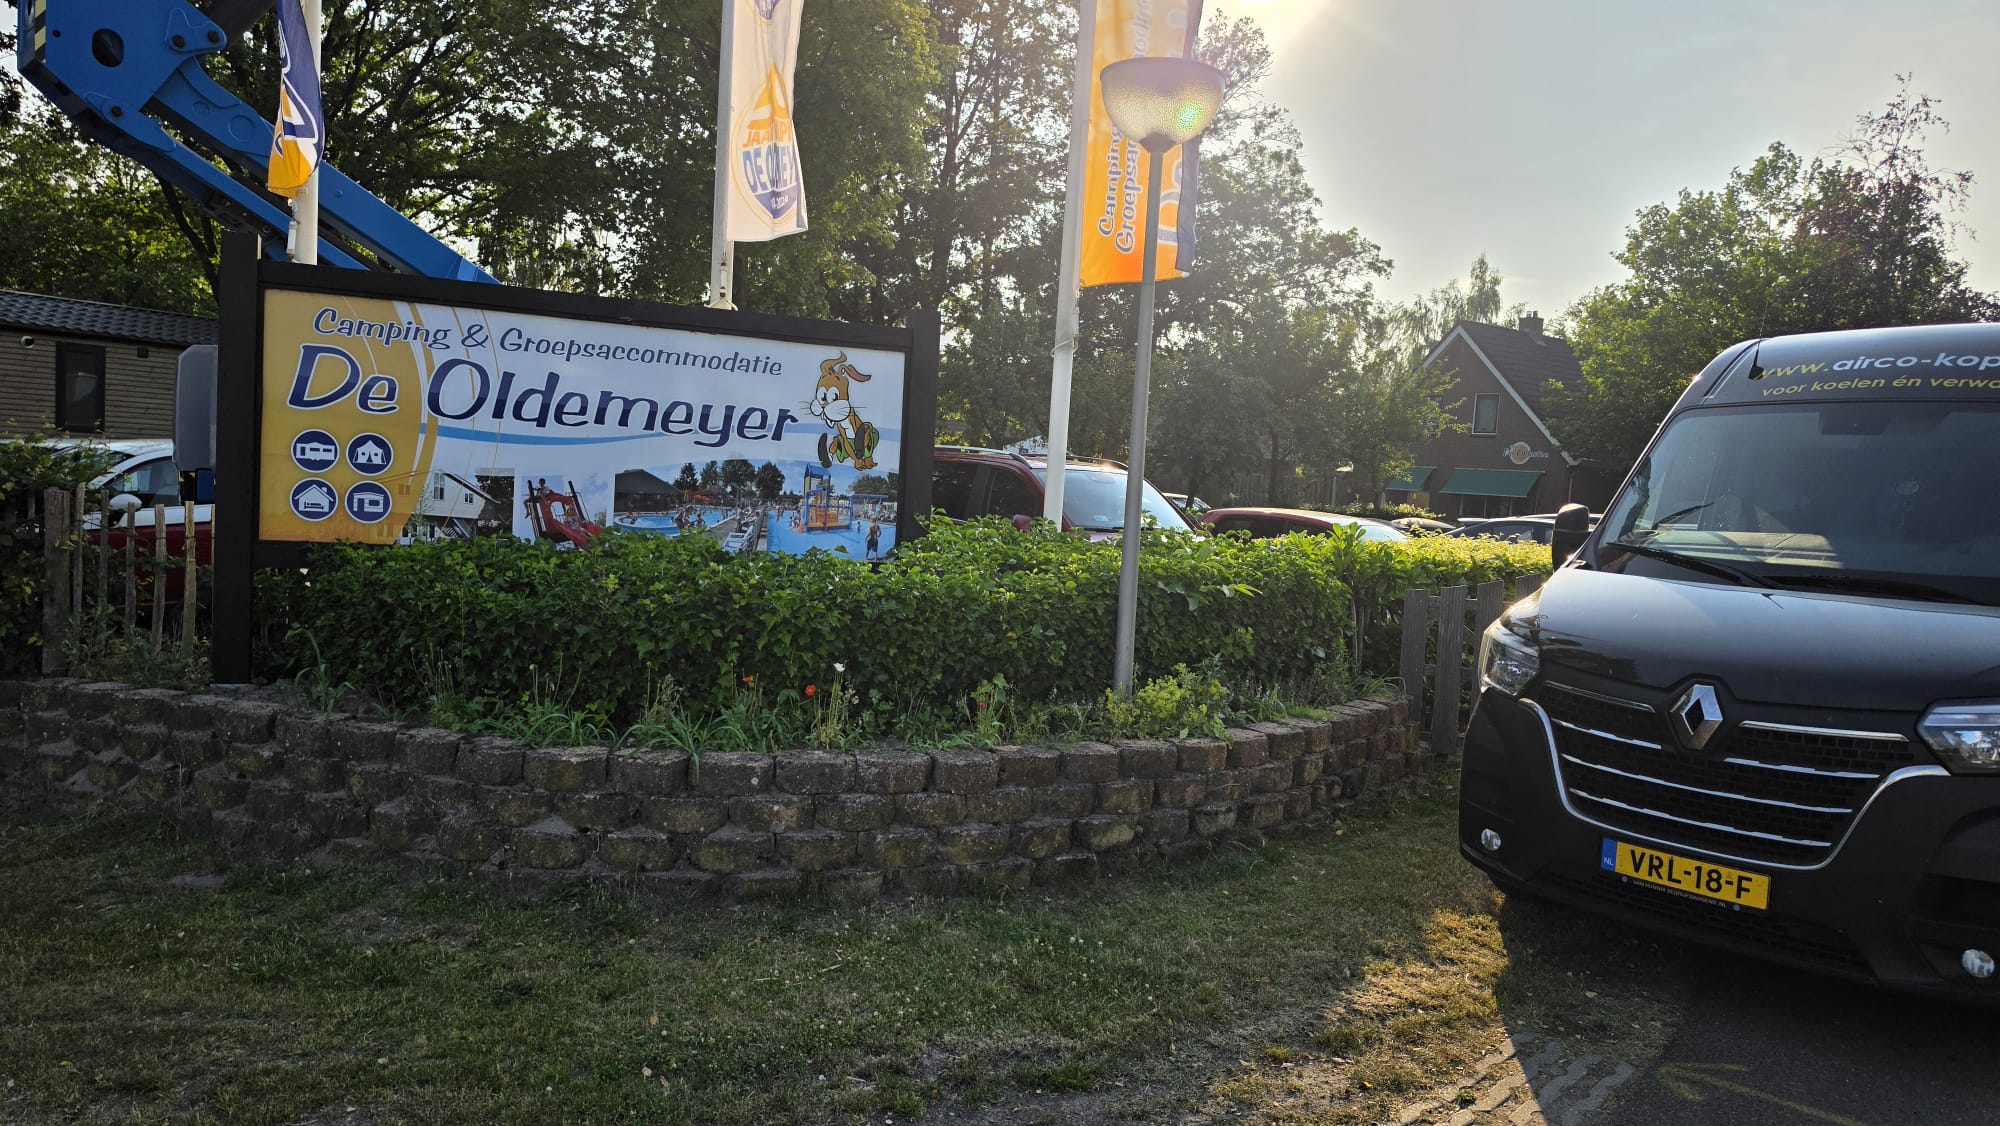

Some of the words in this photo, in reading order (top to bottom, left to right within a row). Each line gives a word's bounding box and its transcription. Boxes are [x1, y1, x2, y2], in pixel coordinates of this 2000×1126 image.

[314, 308, 451, 350] Camping
[461, 324, 489, 349] &
[500, 327, 782, 376] Groepsaccommodatie
[288, 344, 399, 413] De
[428, 358, 799, 448] Oldemeyer
[1763, 384, 1807, 397] voor
[1811, 377, 1885, 392] koelen
[1892, 375, 1921, 387] én
[1603, 856, 1615, 866] NL
[1630, 849, 1752, 899] VRL-18-F
